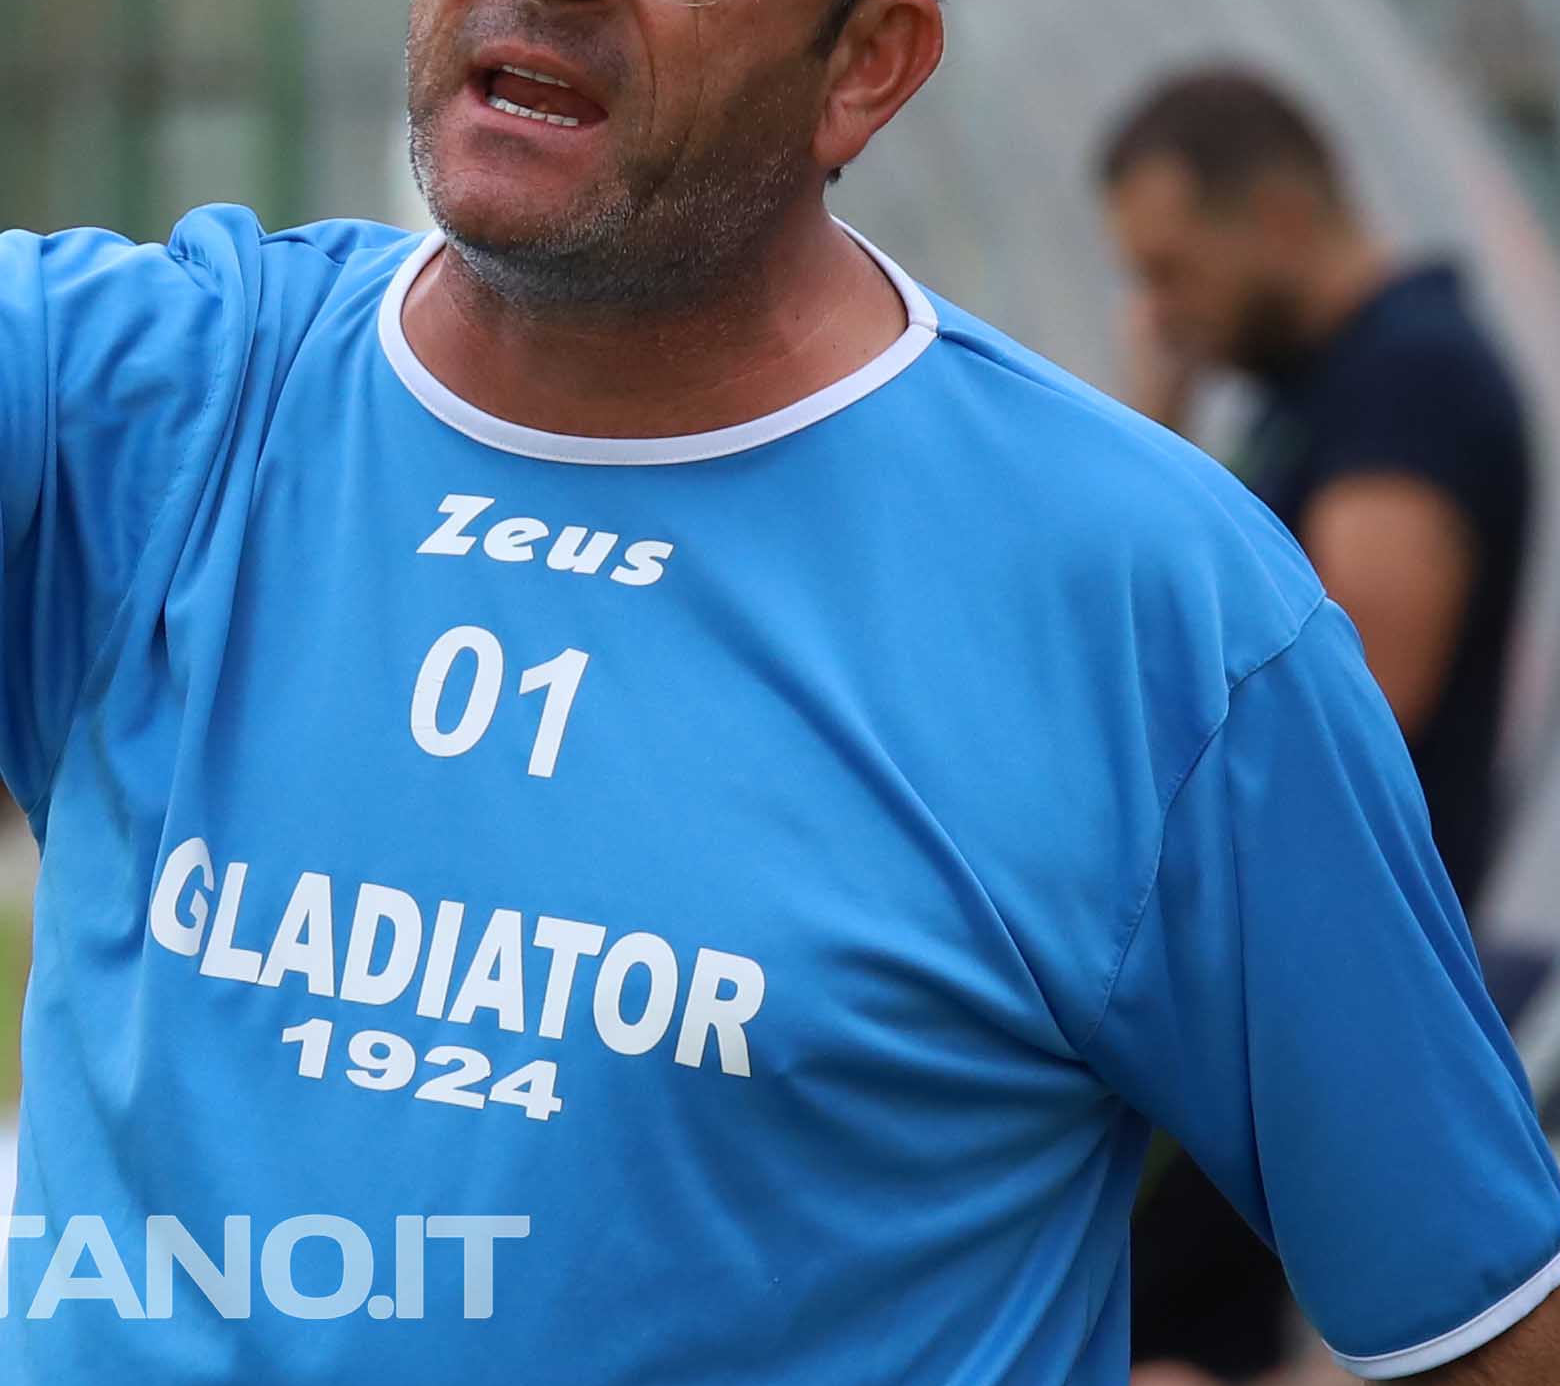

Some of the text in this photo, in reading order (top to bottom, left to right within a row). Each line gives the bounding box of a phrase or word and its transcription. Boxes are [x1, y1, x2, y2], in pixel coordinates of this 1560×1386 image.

[418, 494, 674, 586] Zeus
[409, 625, 590, 777] 01
[150, 837, 765, 1077] GLADIATOR
[282, 1019, 563, 1120] 1924
